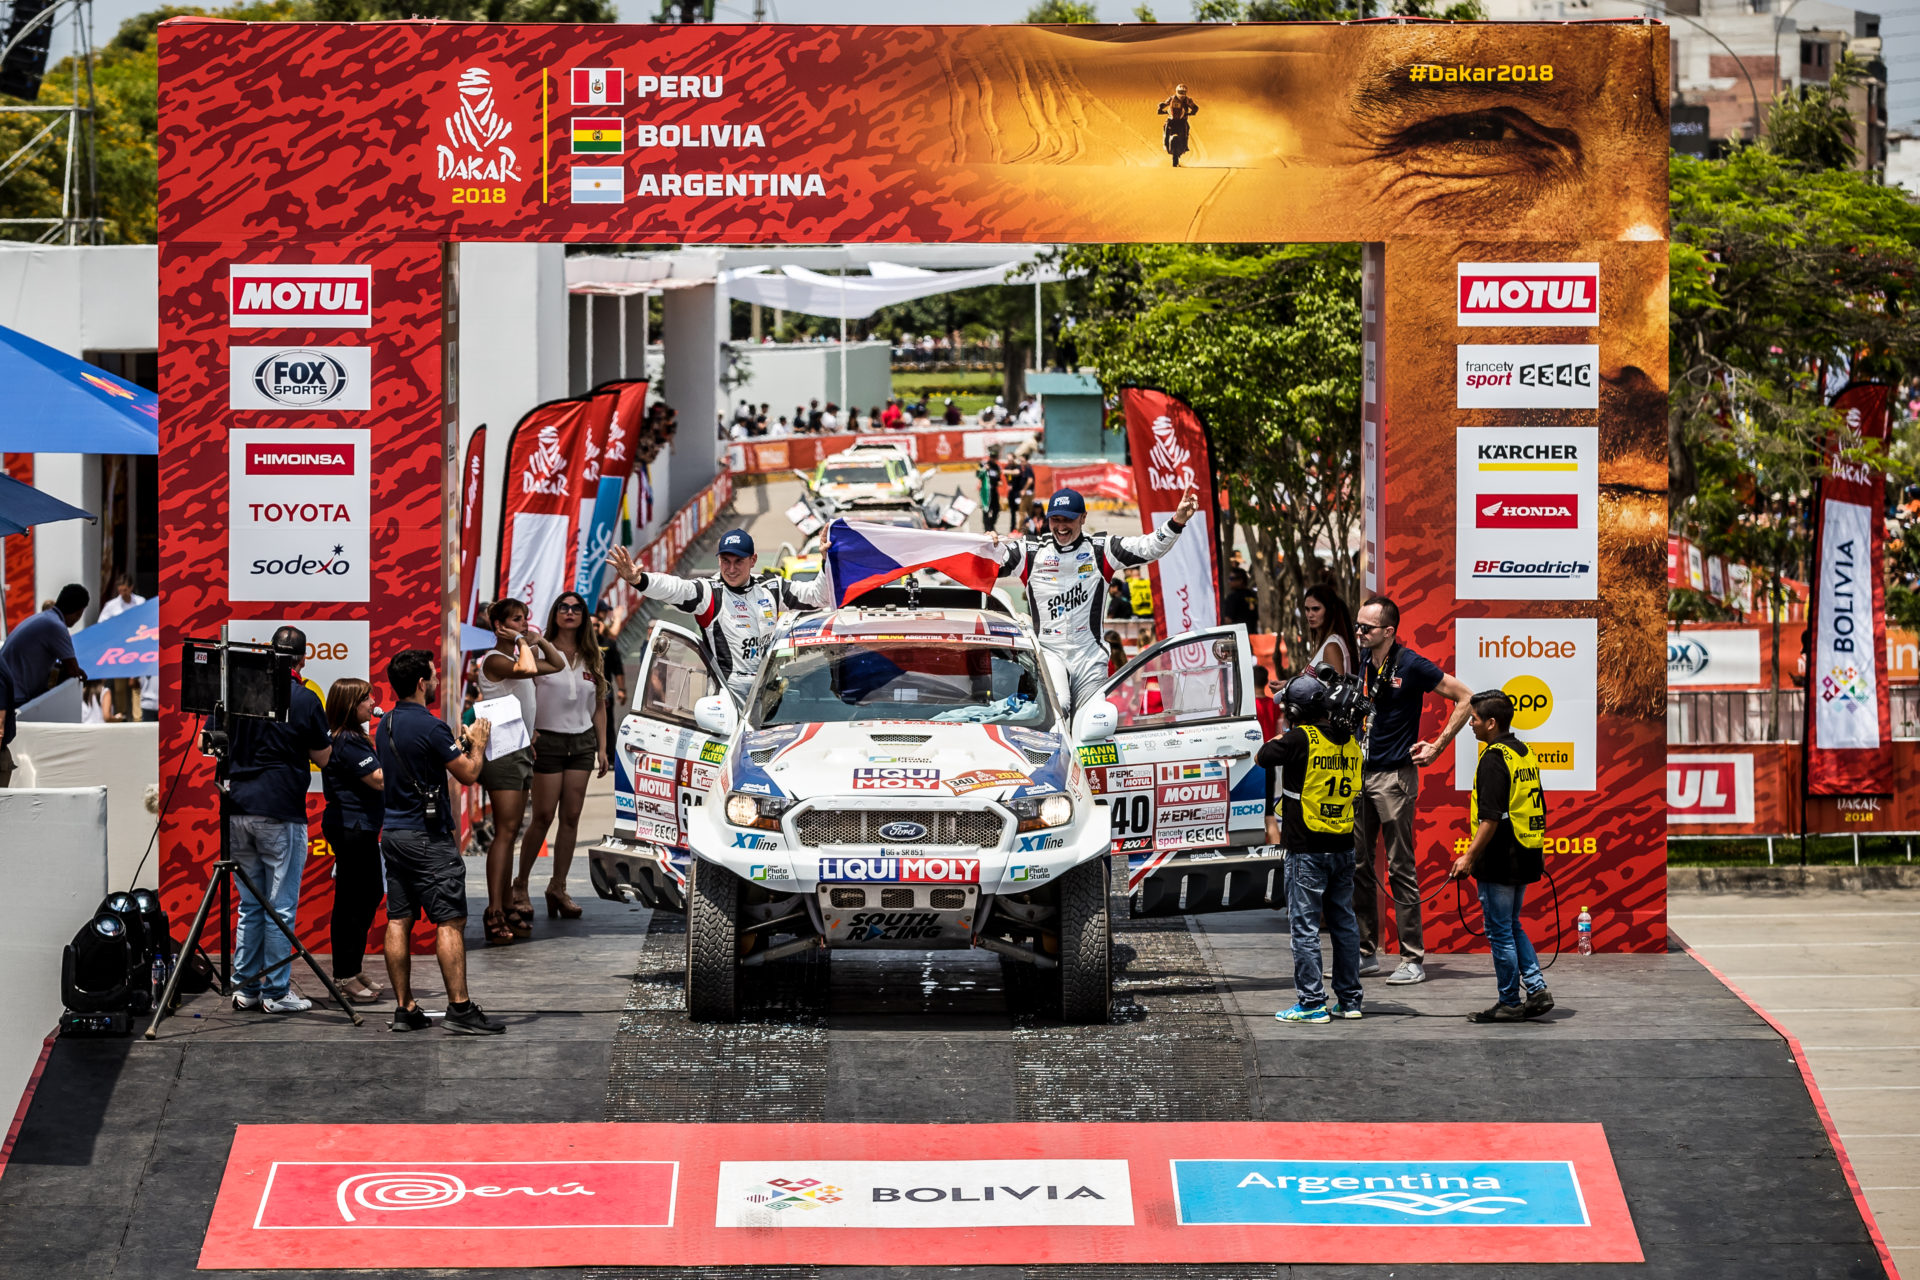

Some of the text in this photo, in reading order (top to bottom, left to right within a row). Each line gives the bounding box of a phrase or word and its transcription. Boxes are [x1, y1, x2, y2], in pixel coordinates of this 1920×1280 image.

[1409, 65, 1554, 82] #Dakar2018
[637, 75, 724, 98] PERU
[637, 124, 766, 147] BOLIVIA
[437, 144, 522, 183] DAKAR
[637, 173, 826, 196] ARGENTINA
[452, 187, 507, 204] 2018
[238, 282, 363, 310] MOTUL
[1465, 280, 1591, 309] MOTUL
[274, 361, 327, 384] FOX
[1465, 361, 1514, 372] francetv
[274, 385, 328, 395] SPORTS
[1466, 372, 1512, 389] sport
[254, 453, 346, 465] HIMOINSA
[1478, 445, 1578, 460] KÄRCHER
[523, 471, 570, 497] DAKAR
[1147, 465, 1200, 490] DAKAR
[249, 503, 351, 522] TOYOTA
[1502, 506, 1572, 517] HONDA
[250, 554, 350, 576] sodexo
[1473, 560, 1592, 574] BFGoodrich
[1047, 582, 1083, 611] SOUTH
[1834, 539, 1855, 653] BOLIVIA
[1479, 635, 1576, 659] infobae
[1080, 745, 1116, 756] MANN
[1081, 754, 1117, 766] FILTER
[1537, 750, 1568, 763] ercio
[856, 779, 937, 788] MOLY
[858, 769, 936, 779] LIQUI
[949, 777, 975, 787] 340
[638, 777, 672, 798] MOTUL
[1163, 784, 1221, 803] MOTUL
[1324, 776, 1352, 798] 16
[1667, 770, 1727, 809] UL
[1095, 795, 1150, 834] 40
[1231, 803, 1264, 816] TECHO
[1844, 812, 1873, 822] 2018
[889, 824, 916, 836] Ford
[731, 832, 777, 851] XTline
[1017, 833, 1063, 853] XTline
[823, 859, 979, 880] LIQUI MOLY
[848, 913, 941, 926] SOUTH
[1236, 1171, 1501, 1193] Argentina
[872, 1185, 1105, 1202] BOLIVIA
